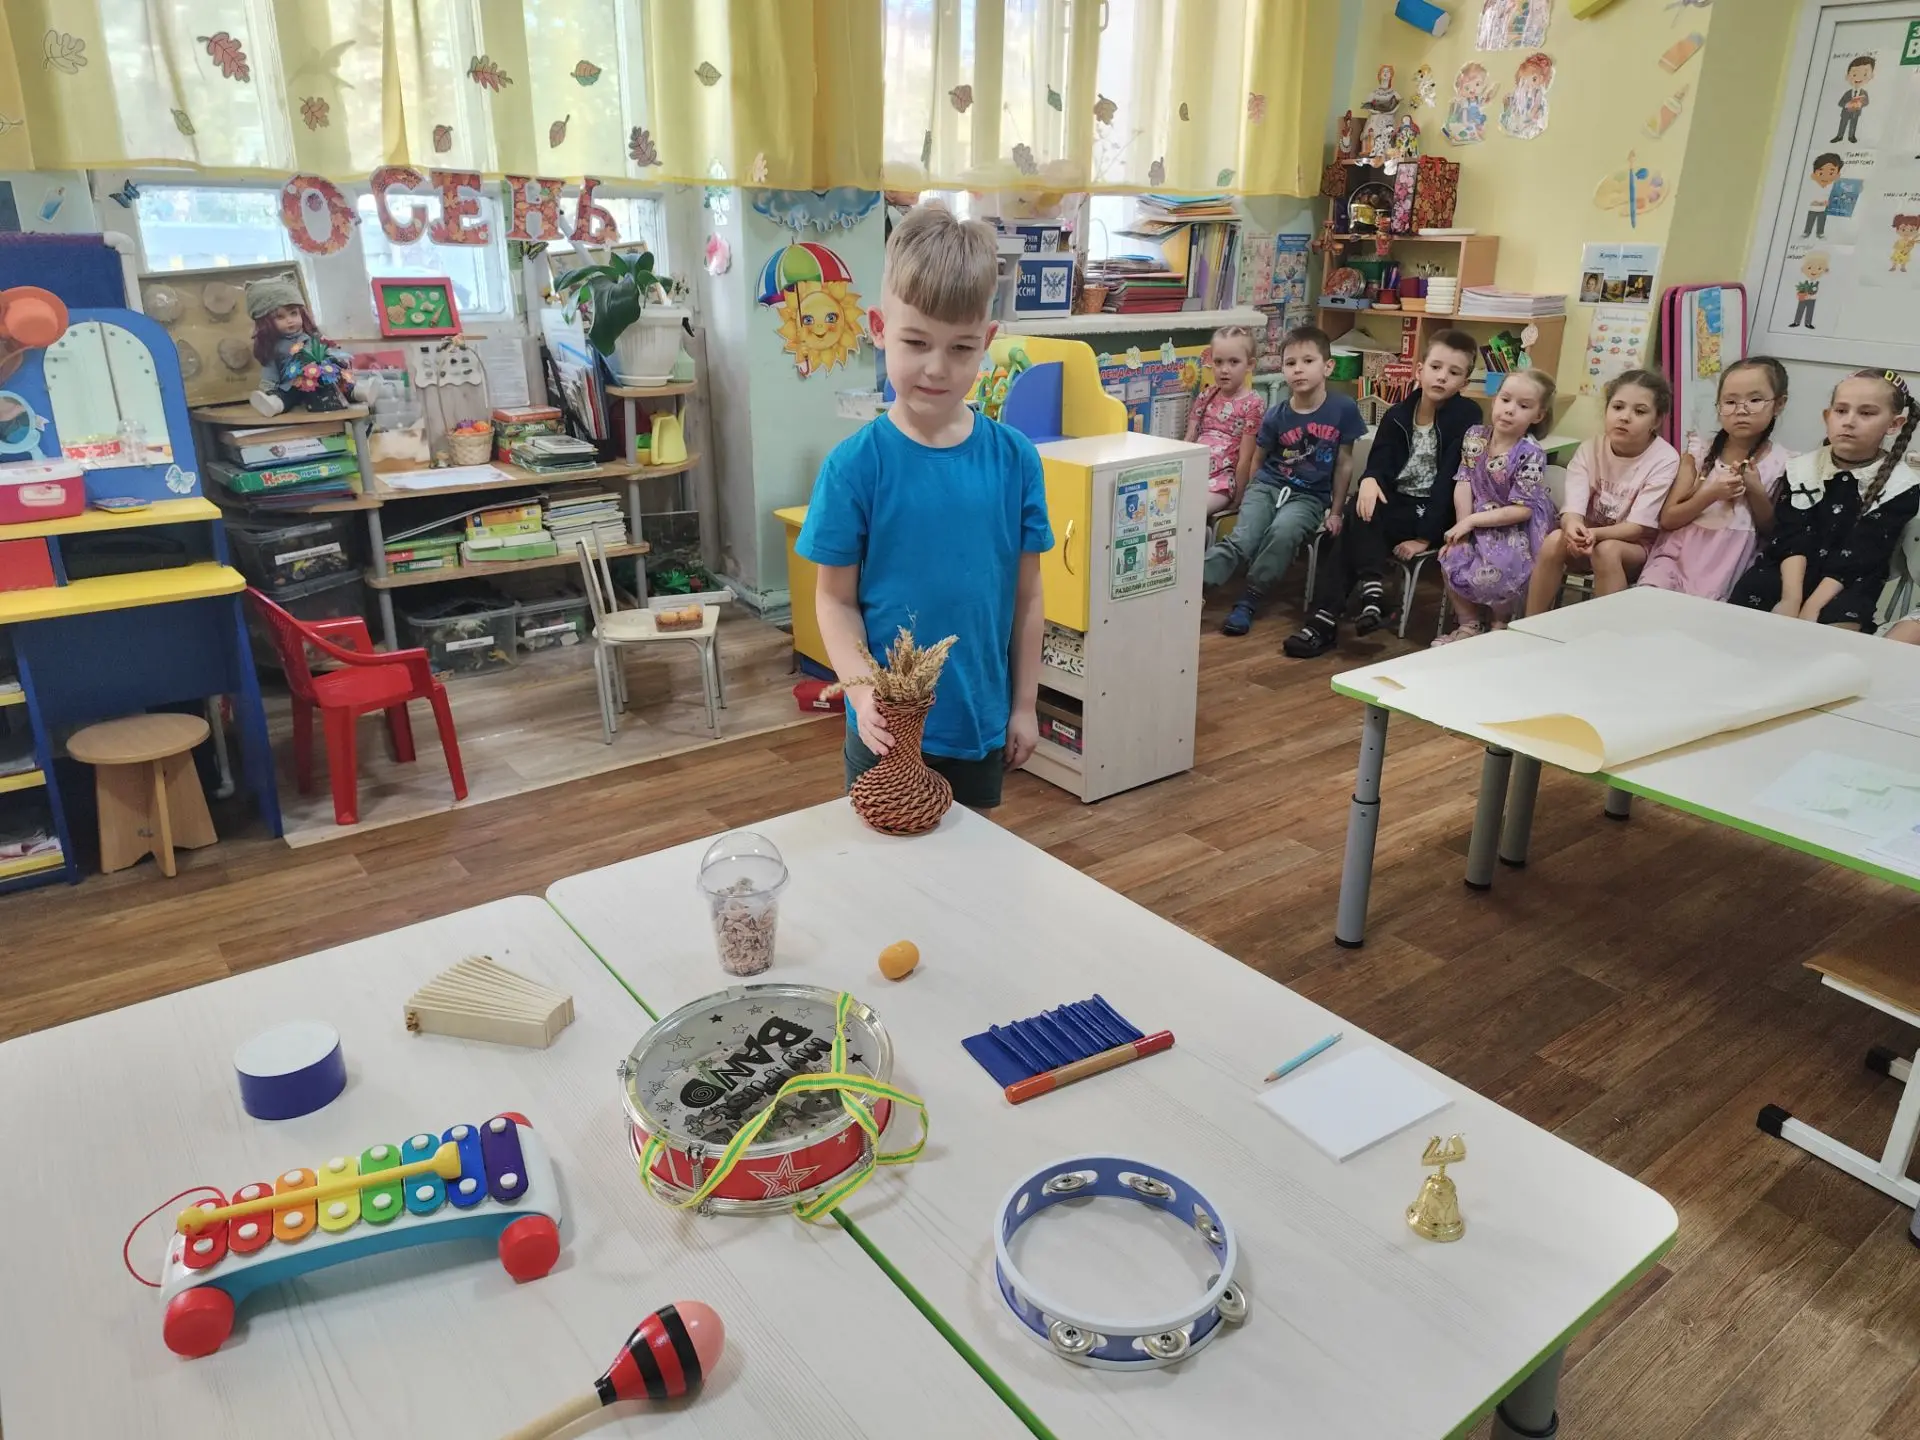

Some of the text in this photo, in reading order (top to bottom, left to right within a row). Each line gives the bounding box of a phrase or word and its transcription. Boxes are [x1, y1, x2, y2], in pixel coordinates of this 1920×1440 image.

[281, 165, 621, 256] ОСЕНЬ
[1016, 286, 1036, 297] ССИИ
[680, 1016, 813, 1108] BAND
